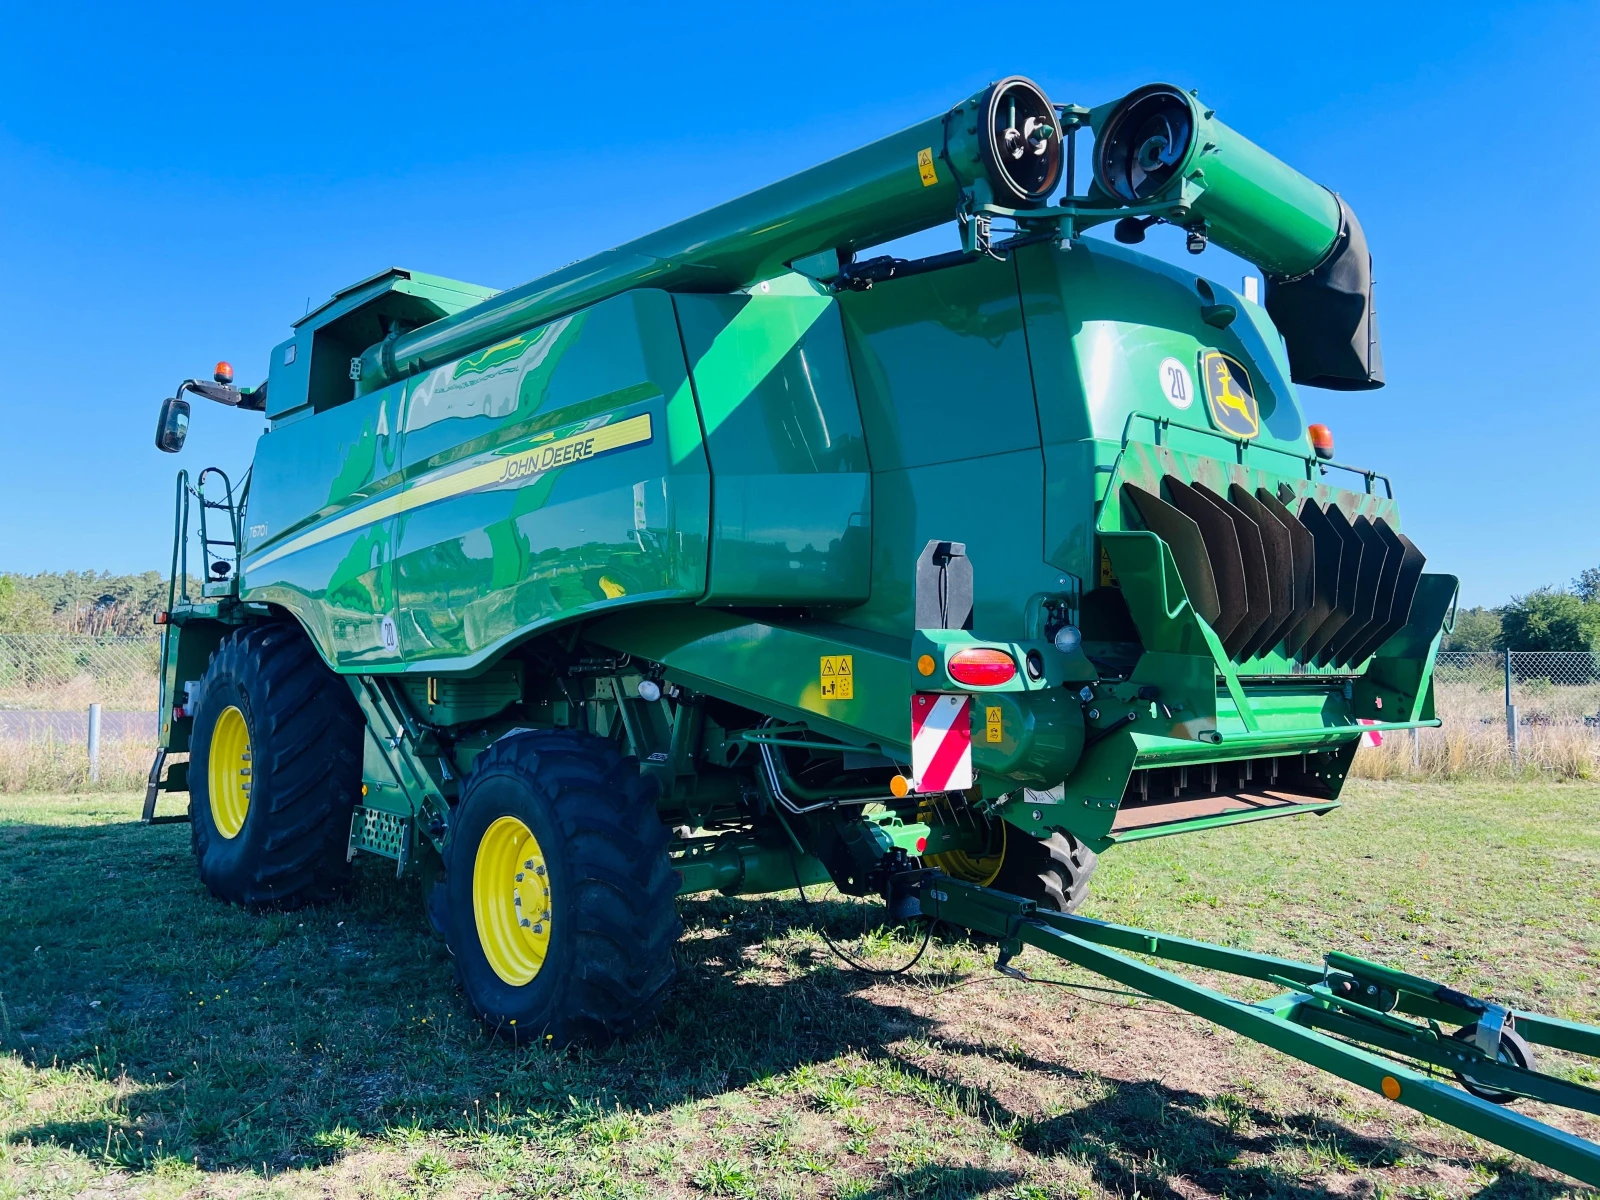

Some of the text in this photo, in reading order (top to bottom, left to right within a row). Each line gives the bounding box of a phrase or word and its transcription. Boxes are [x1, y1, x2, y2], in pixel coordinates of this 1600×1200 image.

[1168, 366, 1186, 400] 20
[499, 438, 595, 481] JOHN DEERE
[384, 622, 395, 647] 20
